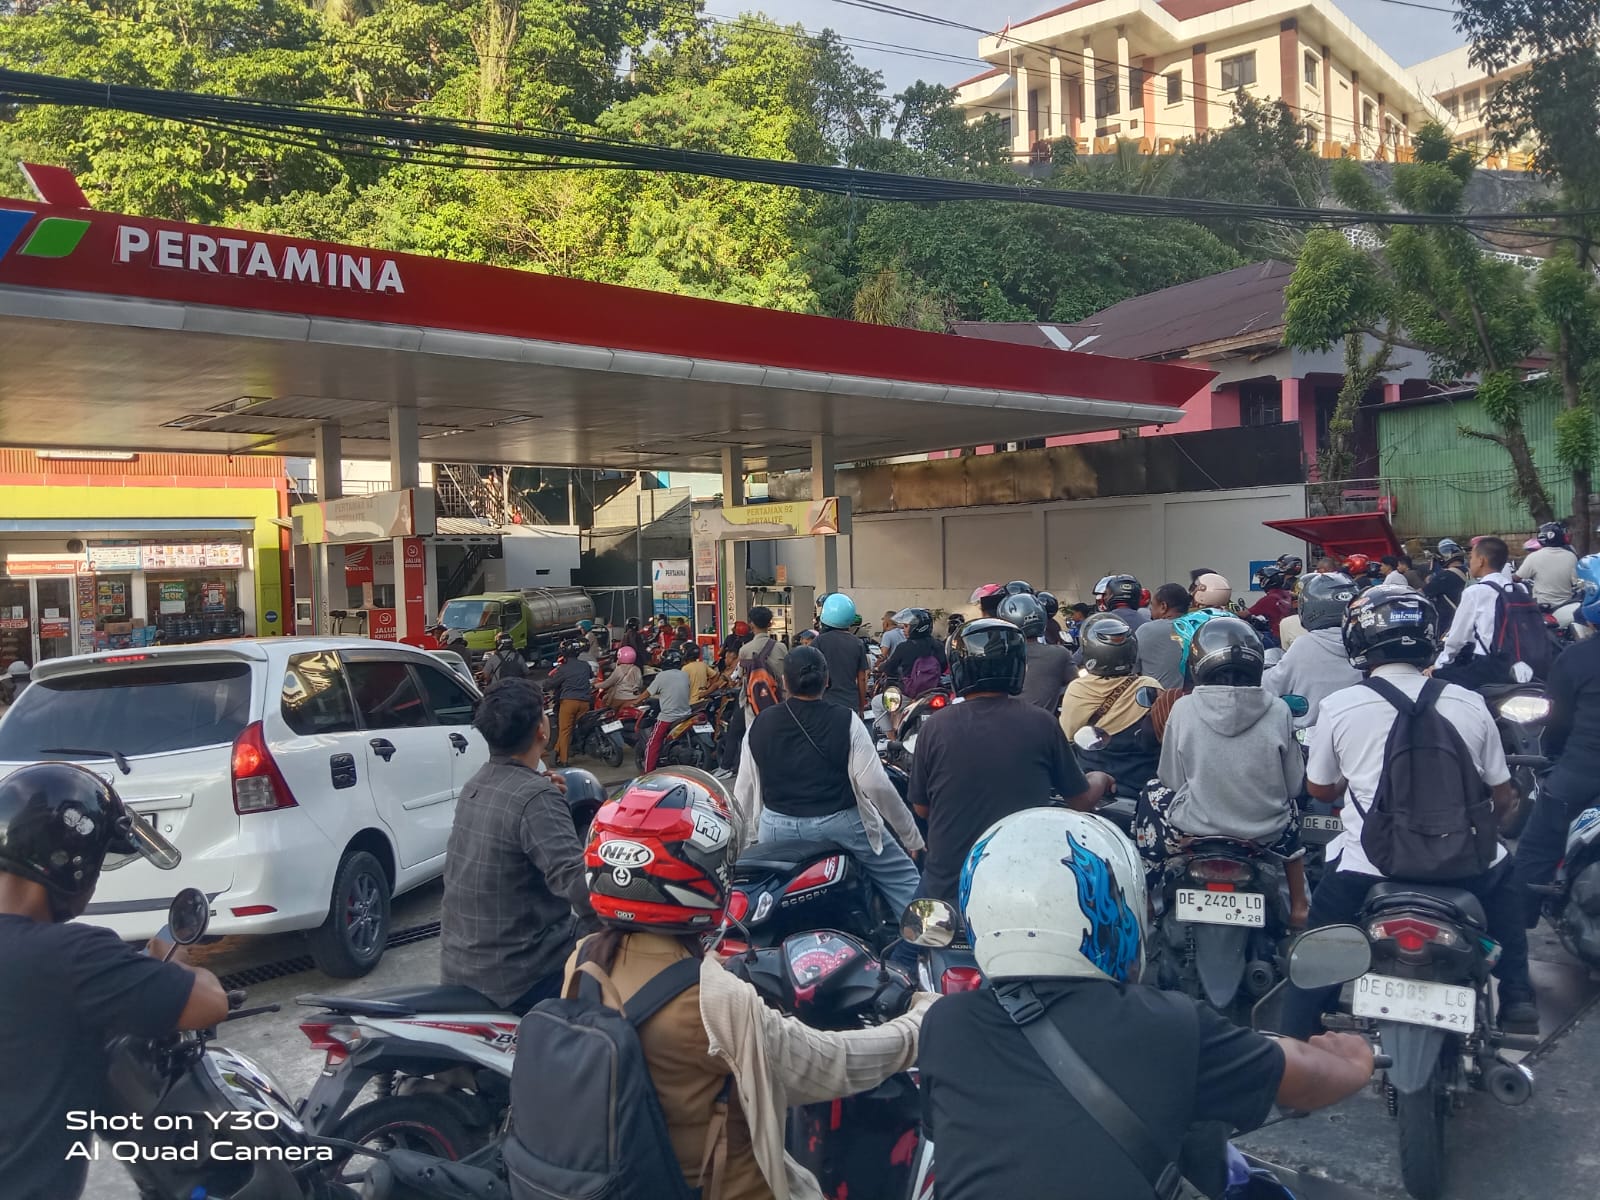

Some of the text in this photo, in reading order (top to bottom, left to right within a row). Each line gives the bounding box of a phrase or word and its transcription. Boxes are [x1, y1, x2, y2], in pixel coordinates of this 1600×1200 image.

[116, 225, 405, 294] PERTAMINA
[746, 507, 784, 516] PERTAMAX
[665, 569, 686, 577] PERTAMINA
[1305, 817, 1319, 828] DE
[603, 845, 646, 862] NHK
[781, 888, 828, 908] SCOOPY
[1179, 892, 1262, 909] DE 2420 LD
